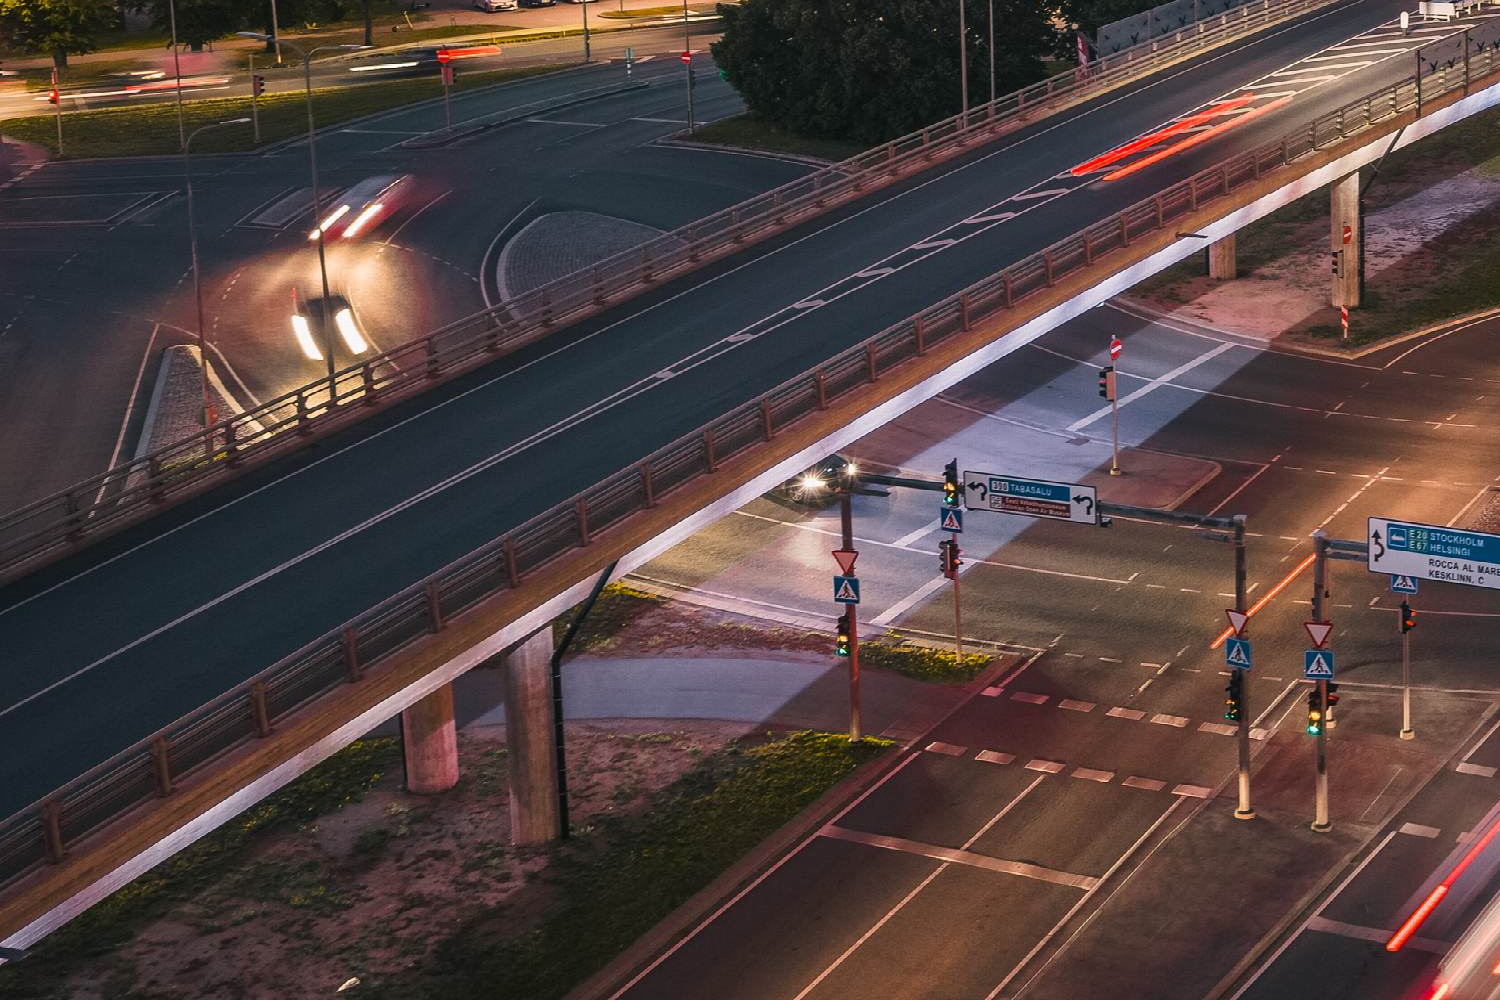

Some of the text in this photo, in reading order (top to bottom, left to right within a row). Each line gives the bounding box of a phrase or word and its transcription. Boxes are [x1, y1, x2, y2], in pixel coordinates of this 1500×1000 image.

[1010, 484, 1052, 496] TABASALU
[1430, 533, 1484, 547] STOCKHOLM
[1430, 544, 1470, 556] HELSINGI
[1428, 558, 1459, 570] ROCCA
[1463, 563, 1474, 573] AL
[1478, 576, 1485, 584] C
